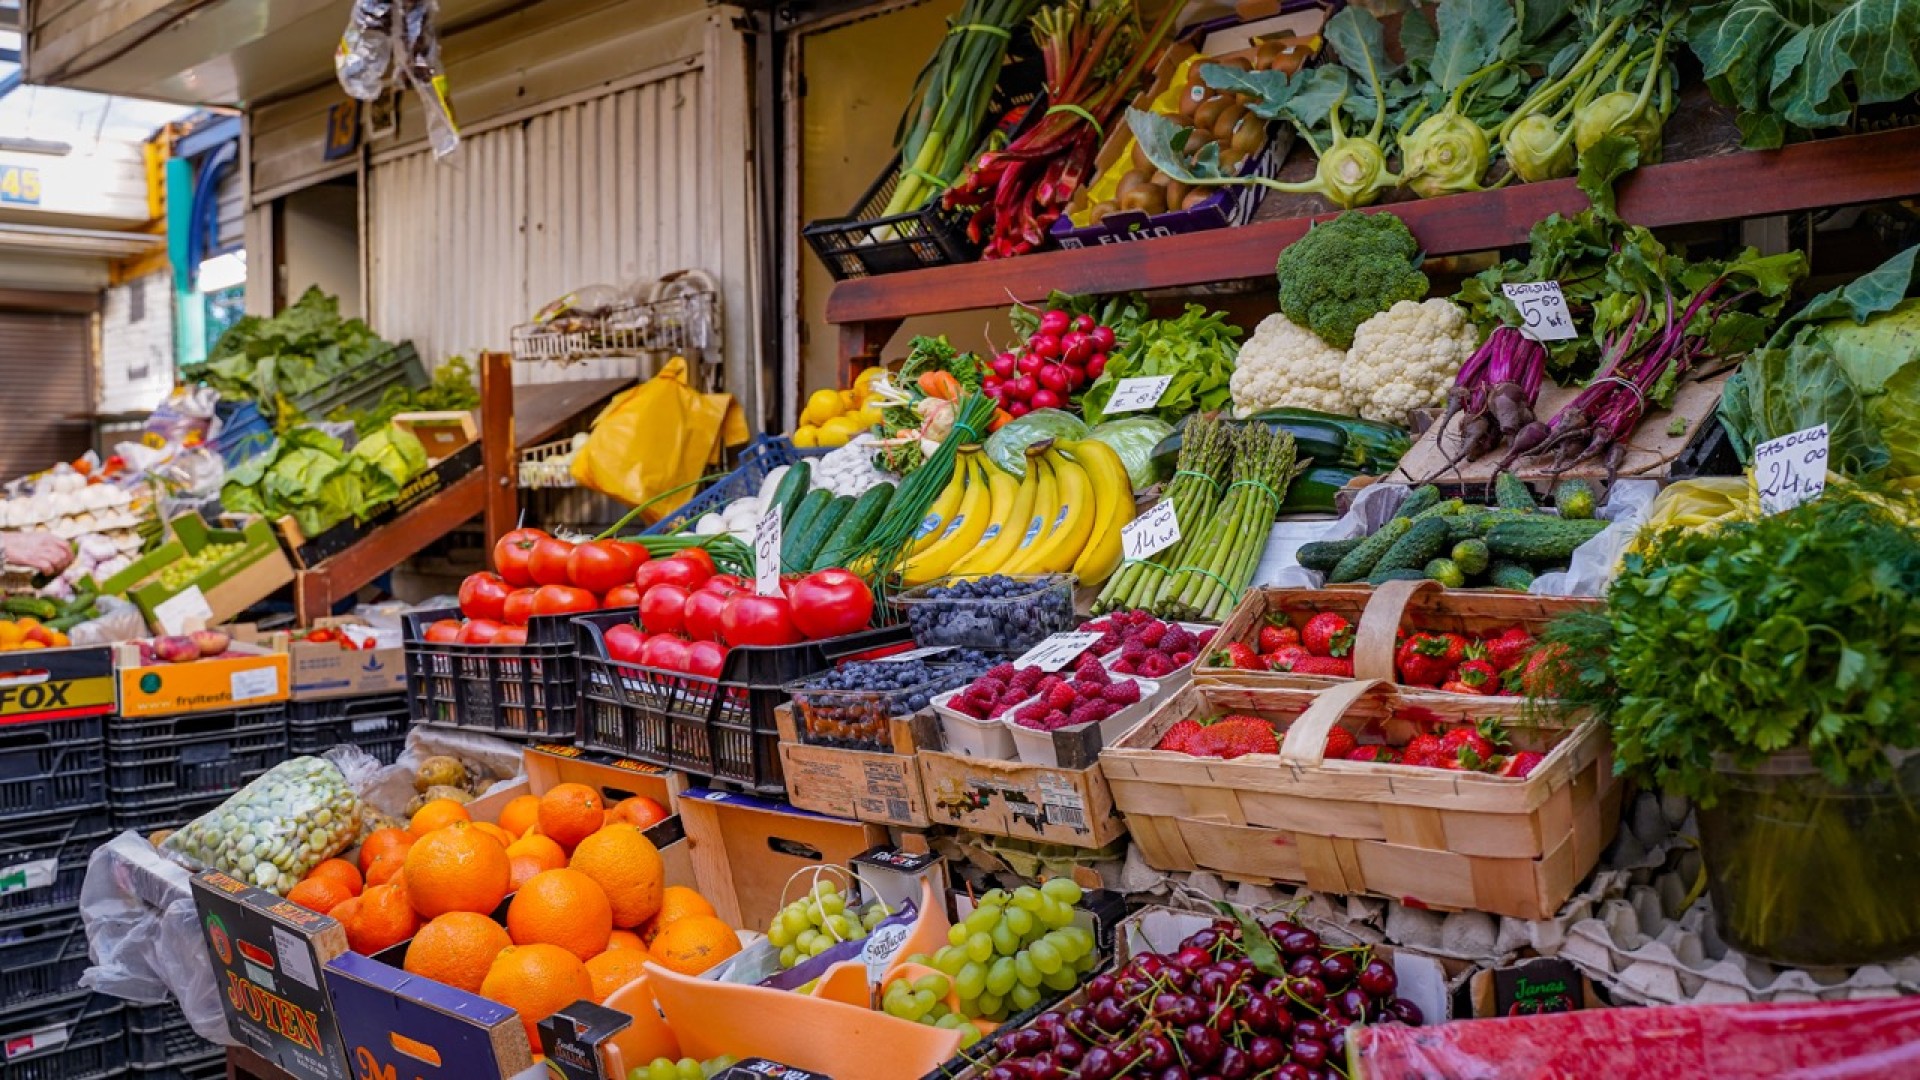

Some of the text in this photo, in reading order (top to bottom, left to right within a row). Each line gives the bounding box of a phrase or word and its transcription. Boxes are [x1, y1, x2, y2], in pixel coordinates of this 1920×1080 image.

[1522, 298, 1541, 327] 5
[1759, 459, 1799, 499] 24
[1131, 529, 1156, 557] 14
[226, 969, 324, 1057] JOYEN
